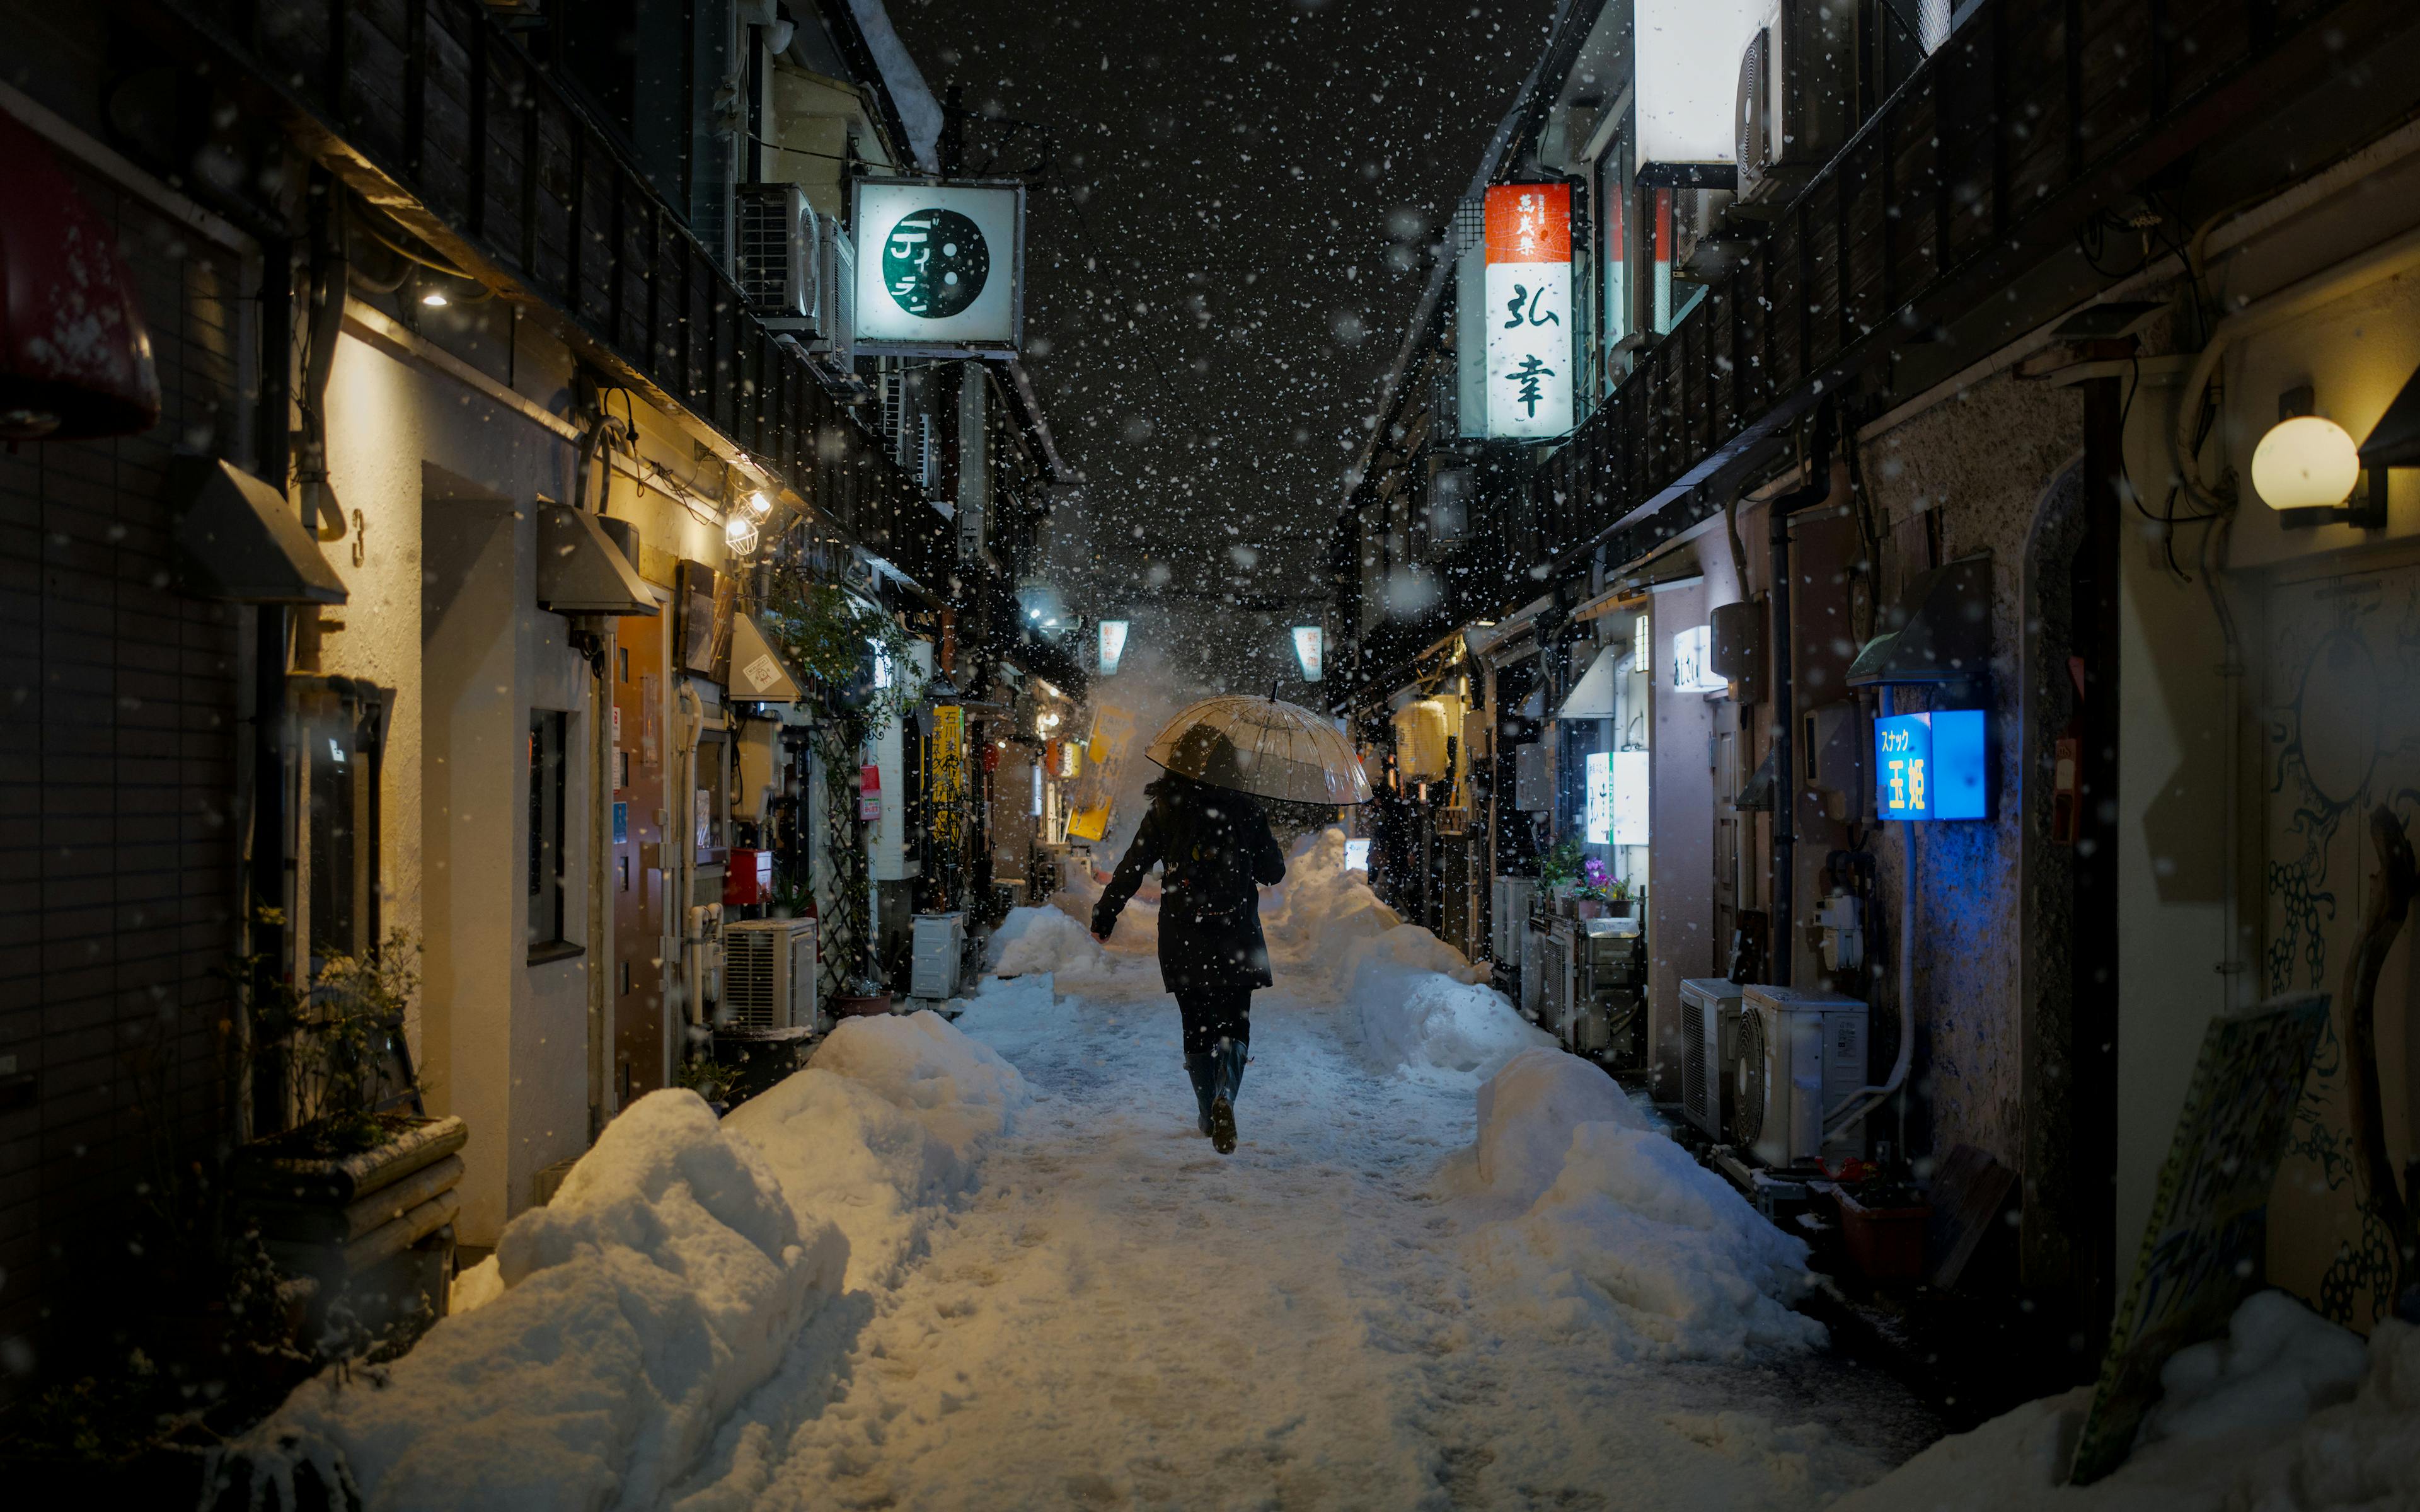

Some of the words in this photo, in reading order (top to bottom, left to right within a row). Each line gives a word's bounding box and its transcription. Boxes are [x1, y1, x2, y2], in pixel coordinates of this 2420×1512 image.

[1504, 284, 1559, 418] 弘幸
[1881, 728, 1909, 752] スナック
[1888, 757, 1925, 811] 玉姫
